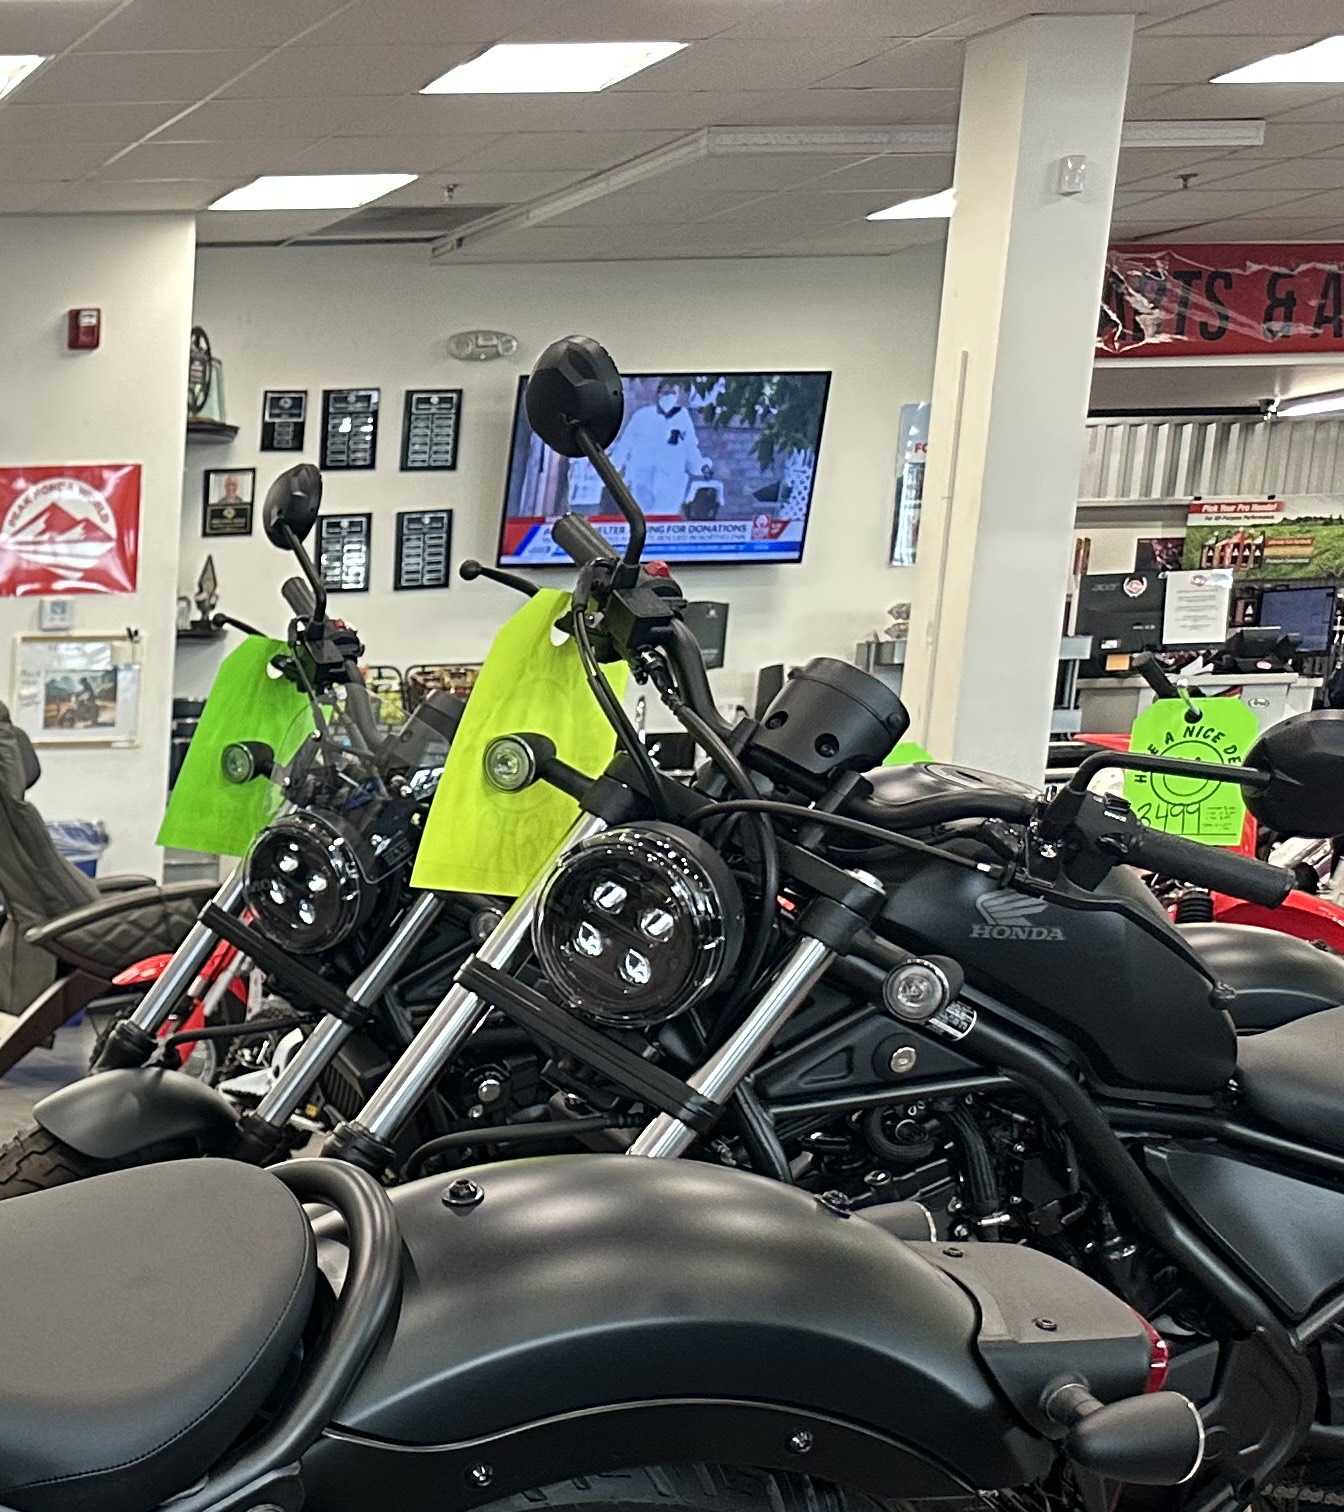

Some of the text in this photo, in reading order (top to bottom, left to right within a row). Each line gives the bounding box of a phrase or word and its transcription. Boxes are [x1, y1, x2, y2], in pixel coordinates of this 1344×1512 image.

[666, 524, 686, 534] FOR
[688, 523, 748, 534] DONATIONS
[1183, 725, 1225, 744] NICE
[969, 925, 1066, 940] HONDA
